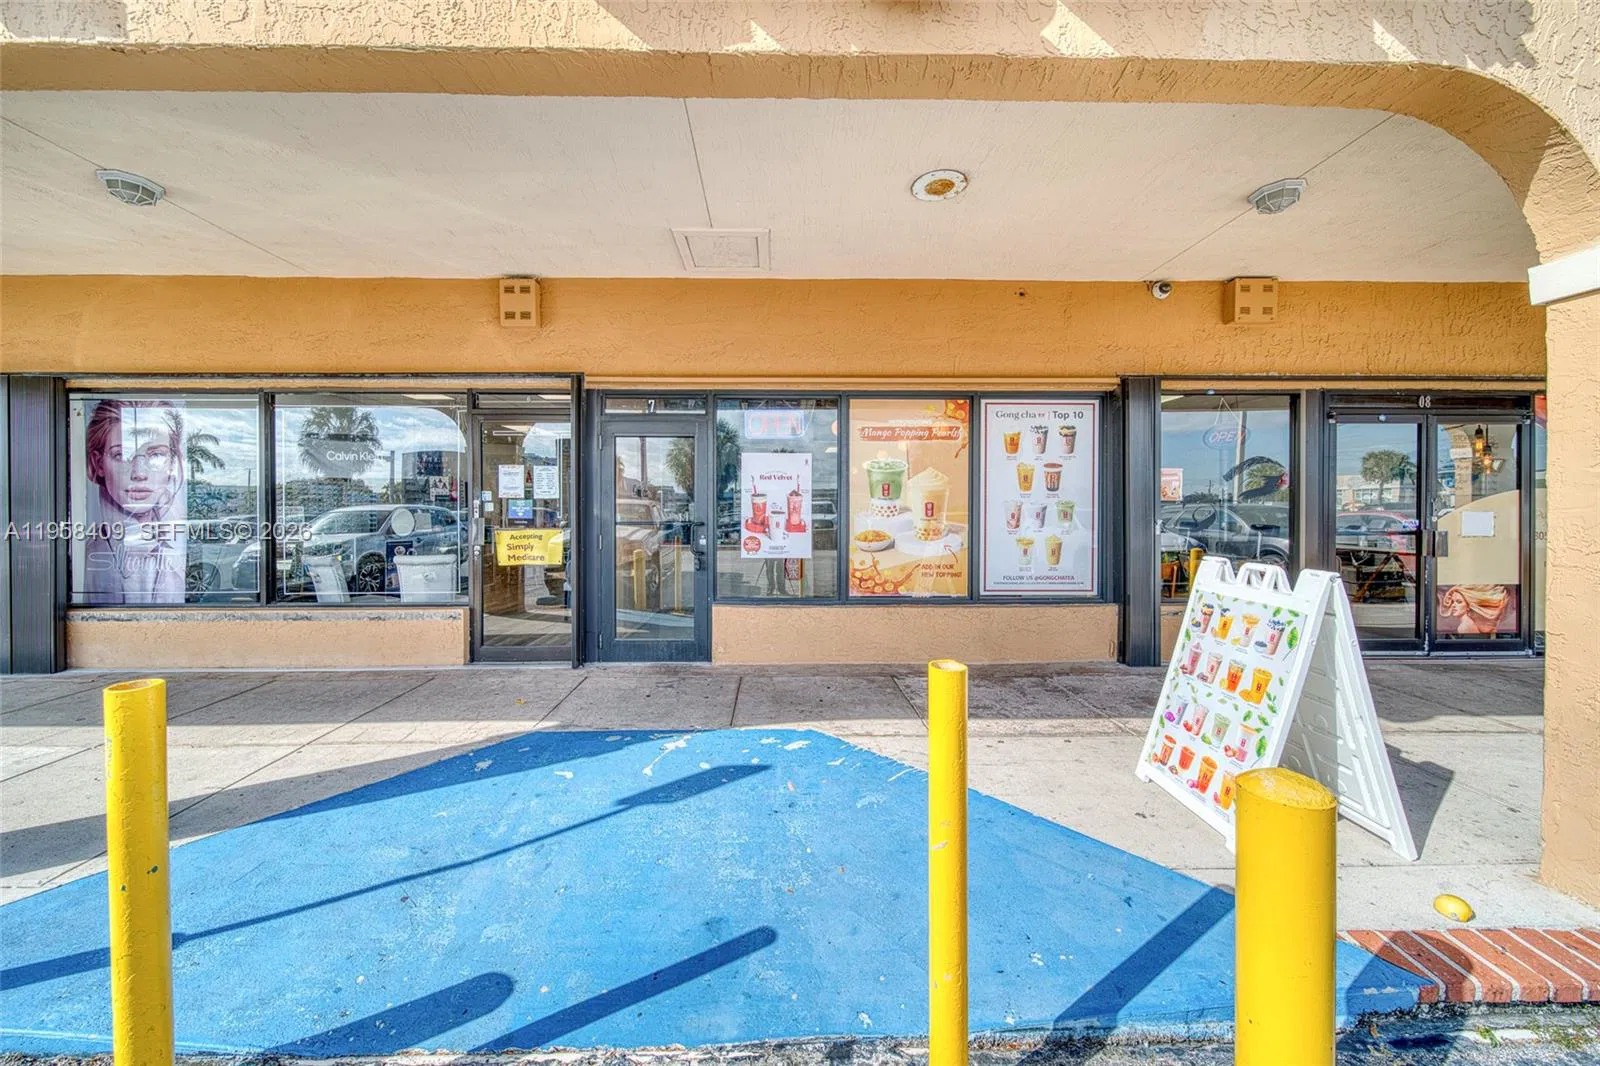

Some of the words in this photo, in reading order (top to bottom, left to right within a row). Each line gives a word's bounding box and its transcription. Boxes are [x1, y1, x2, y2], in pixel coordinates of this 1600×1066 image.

[648, 399, 655, 413] 7
[1418, 395, 1431, 408] 08
[995, 410, 1020, 420] Gong
[1020, 410, 1037, 419] cha
[1052, 410, 1070, 420] Top
[1073, 411, 1084, 419] 10
[863, 427, 893, 439] Mango
[894, 428, 930, 440] Popping
[326, 450, 358, 461] Calvin
[509, 533, 544, 542] Accepting
[506, 543, 535, 552] Simply
[507, 554, 545, 562] Medicare
